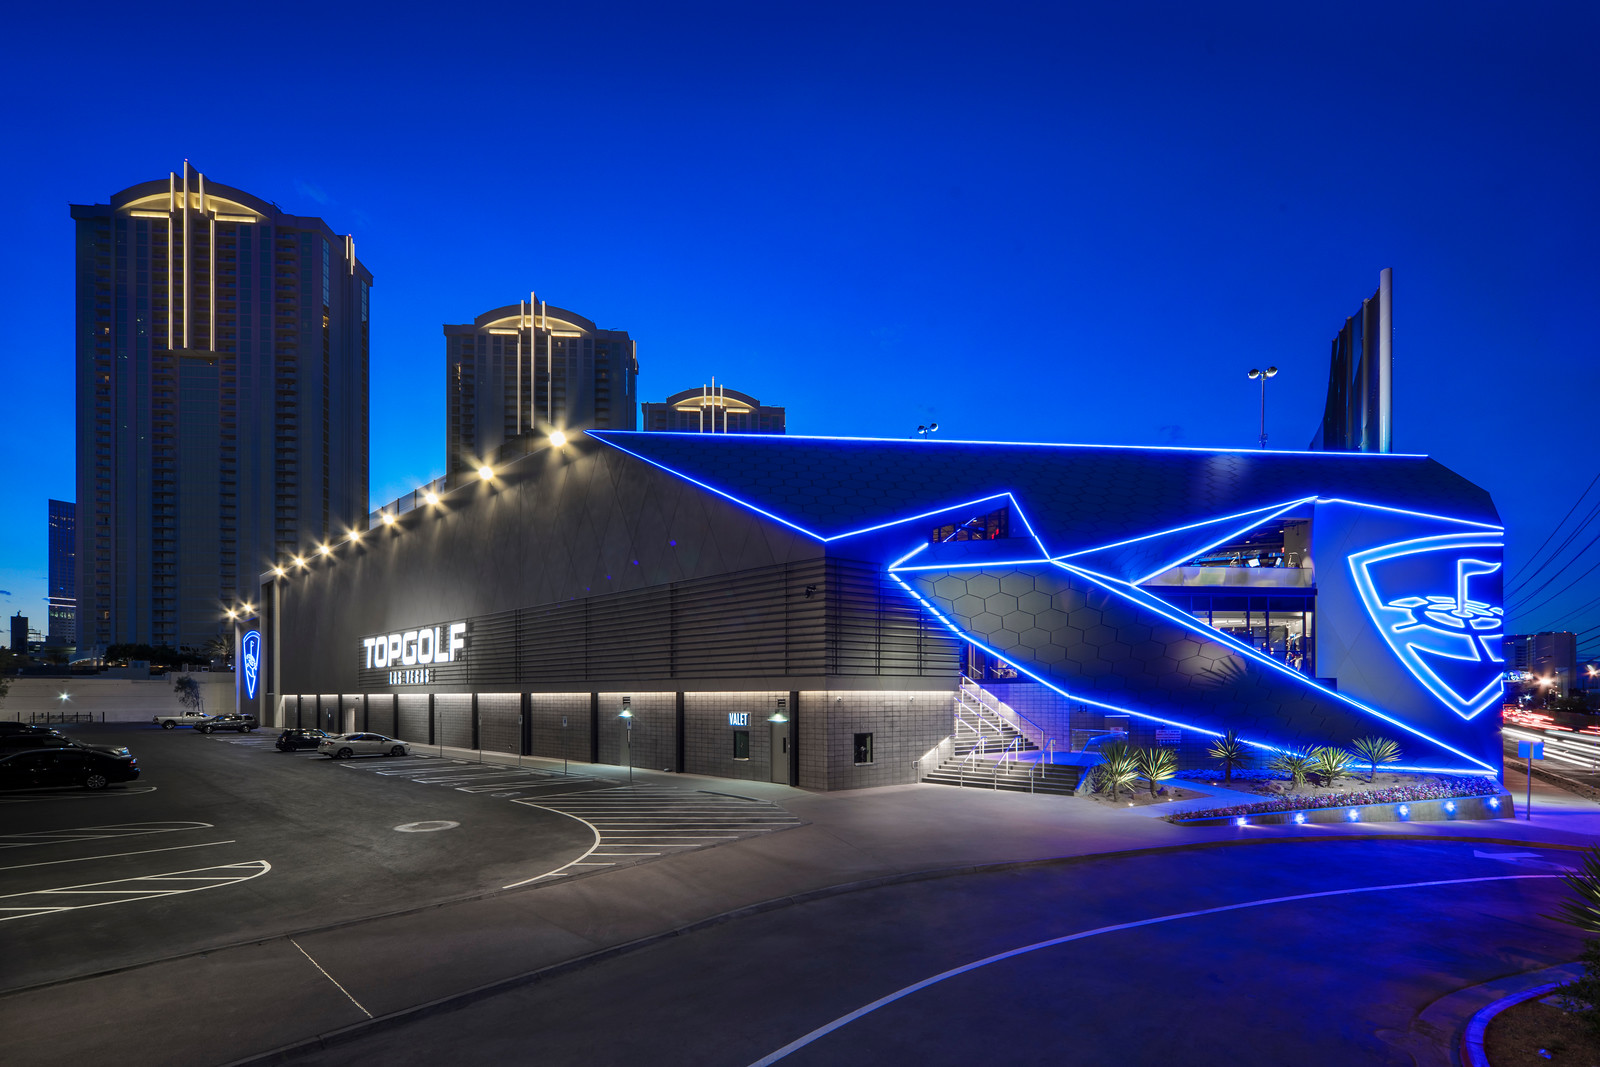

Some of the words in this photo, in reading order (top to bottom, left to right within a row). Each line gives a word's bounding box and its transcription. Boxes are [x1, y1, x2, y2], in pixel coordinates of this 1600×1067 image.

[363, 623, 466, 669] TOPGOLF
[389, 671, 402, 685] LAS
[405, 669, 430, 684] VEGAS
[728, 712, 748, 726] VALET
